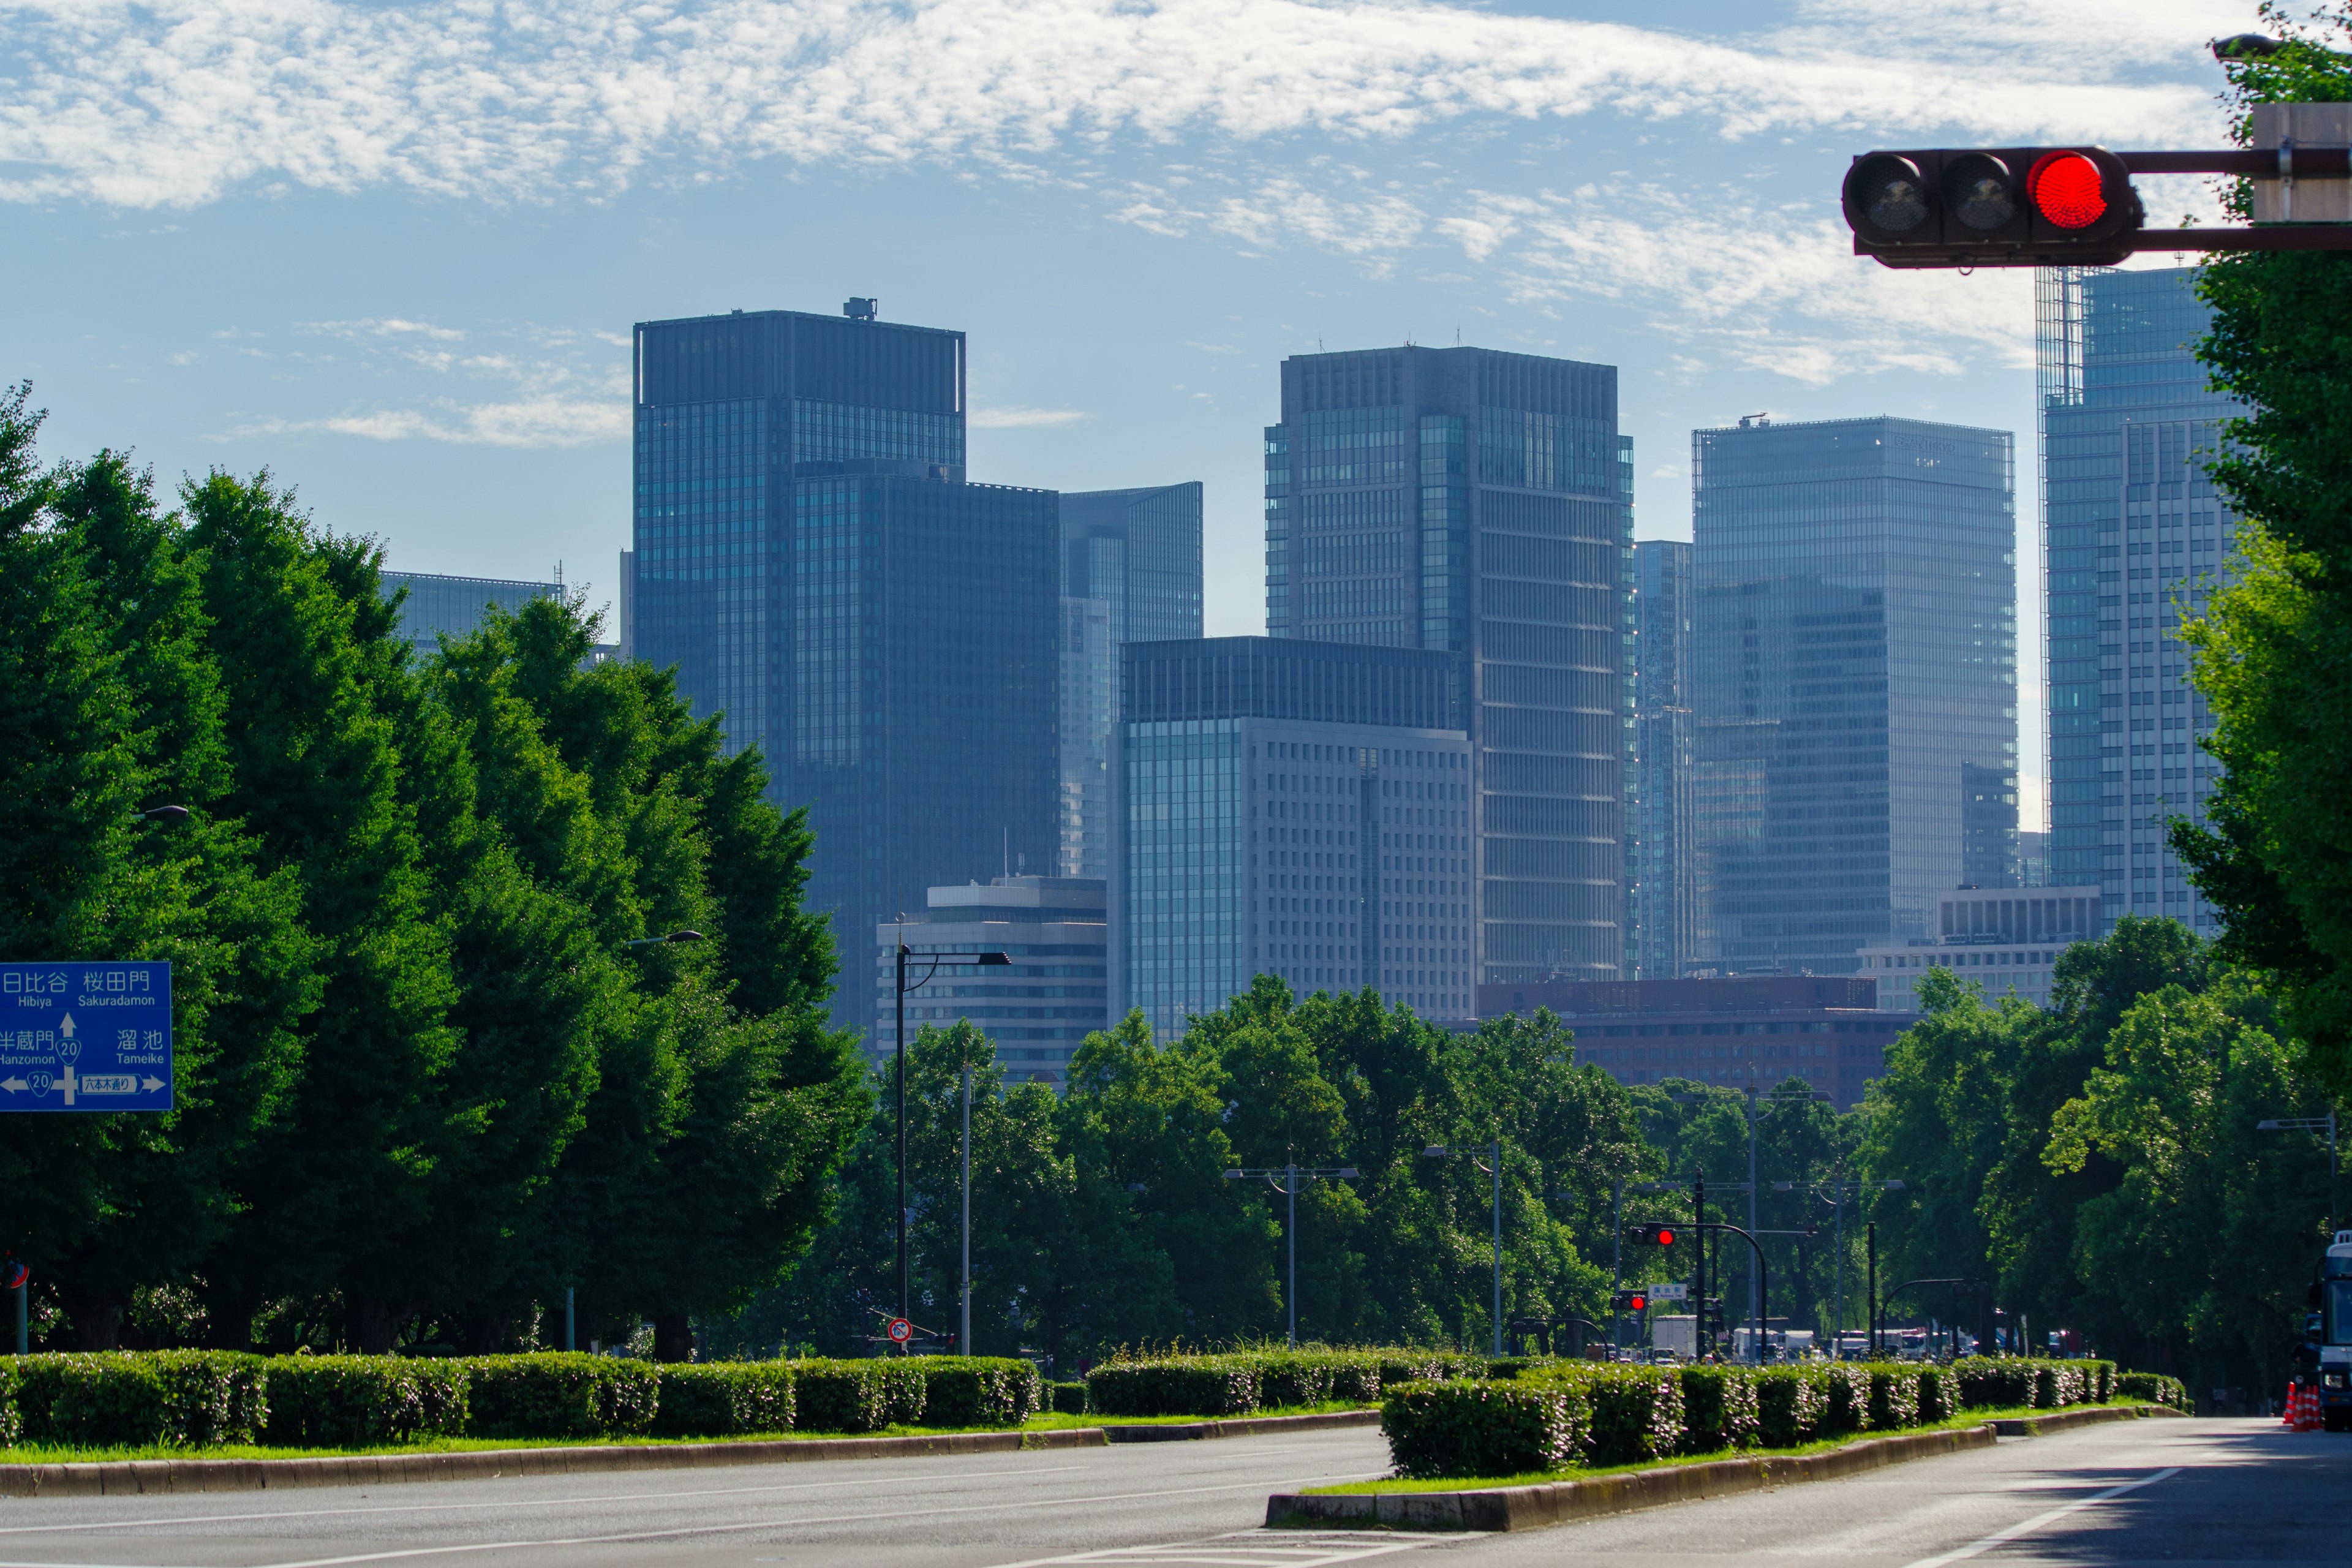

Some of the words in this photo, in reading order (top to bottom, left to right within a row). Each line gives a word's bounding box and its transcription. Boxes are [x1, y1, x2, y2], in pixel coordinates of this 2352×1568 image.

[4, 972, 68, 993] 日比谷
[83, 971, 149, 992] 桜田門
[18, 996, 51, 1009] Hibiya
[78, 995, 155, 1006] Sakuradamon
[0, 1030, 54, 1051] 半蔵門
[117, 1029, 163, 1050] 溜池
[61, 1042, 77, 1055] 20
[116, 1053, 164, 1064] Tameike
[32, 1075, 48, 1088] 20
[85, 1077, 129, 1091] 六本木通り
